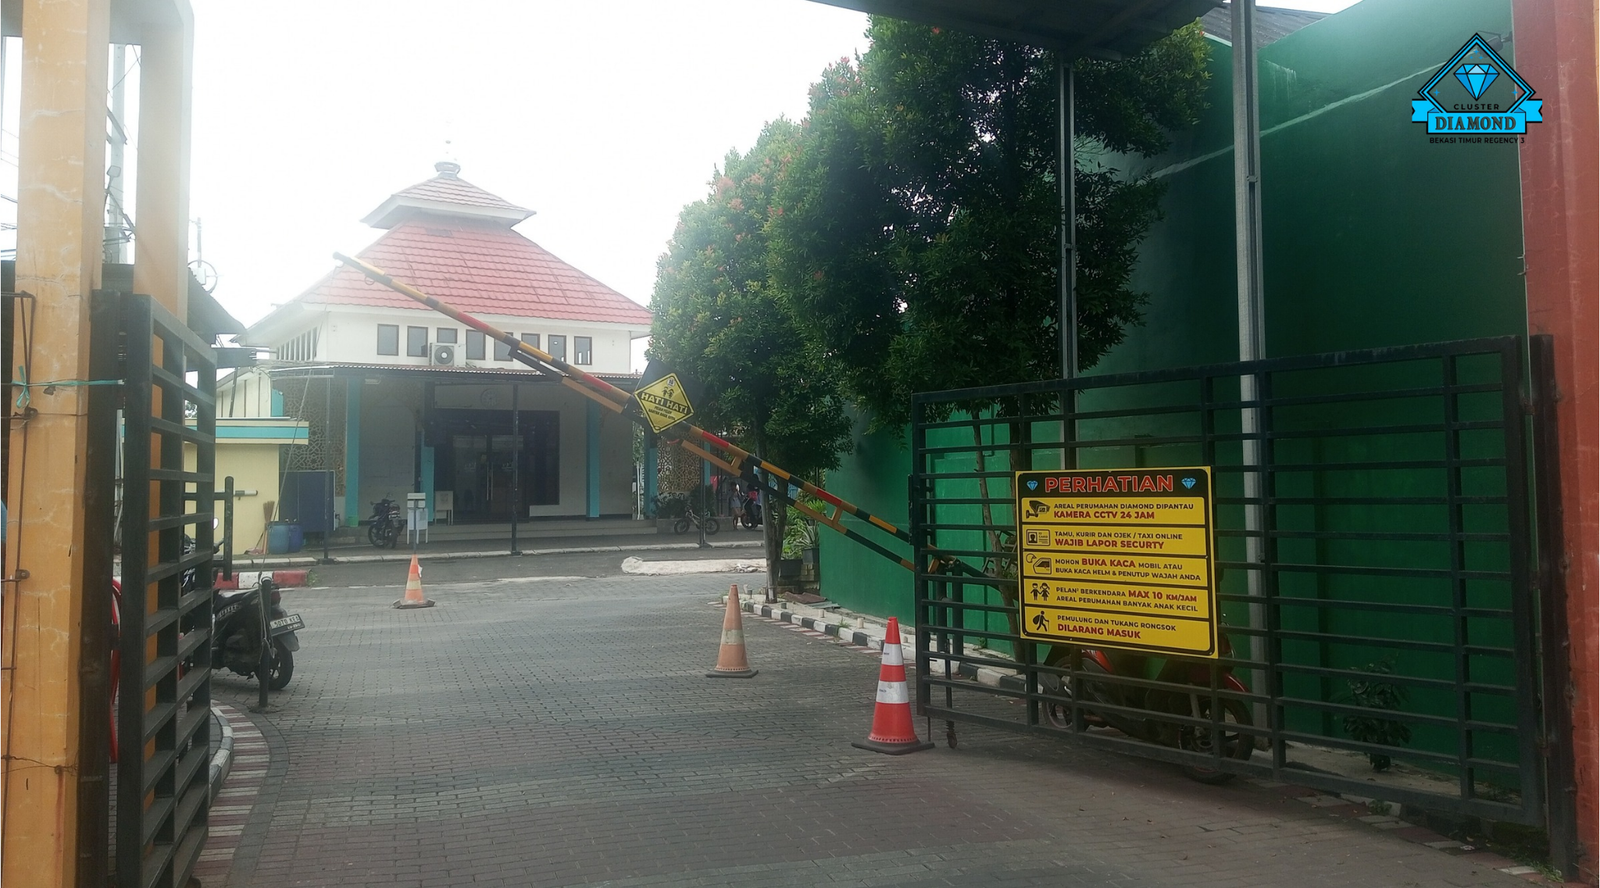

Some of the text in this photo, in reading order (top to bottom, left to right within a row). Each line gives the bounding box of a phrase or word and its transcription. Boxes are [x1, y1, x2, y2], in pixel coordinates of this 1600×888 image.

[641, 392, 665, 405] HATI
[666, 401, 688, 414] HATI
[1045, 474, 1173, 493] PERHATIAN
[1053, 510, 1091, 519] KAMERA
[1093, 511, 1118, 519] CCTV
[1120, 511, 1132, 519] 24
[1134, 511, 1155, 519] JAM
[1054, 538, 1164, 549] WAJIB LAPOR SECURTY
[1081, 558, 1107, 566] BUKA
[1110, 559, 1136, 568] KACA
[1080, 588, 1126, 597] BERKENDARA
[1128, 590, 1150, 599] MAX
[1152, 591, 1163, 600] 10
[1166, 594, 1197, 602] KM/JAM
[1078, 597, 1121, 606] PERUMAHAN
[1122, 600, 1152, 608] BANYAK
[1057, 615, 1093, 623] PEMULUNG
[1110, 620, 1139, 628] TUKANG
[1140, 622, 1176, 631] RONGSOK
[1058, 623, 1141, 639] DILARANG MASUK
